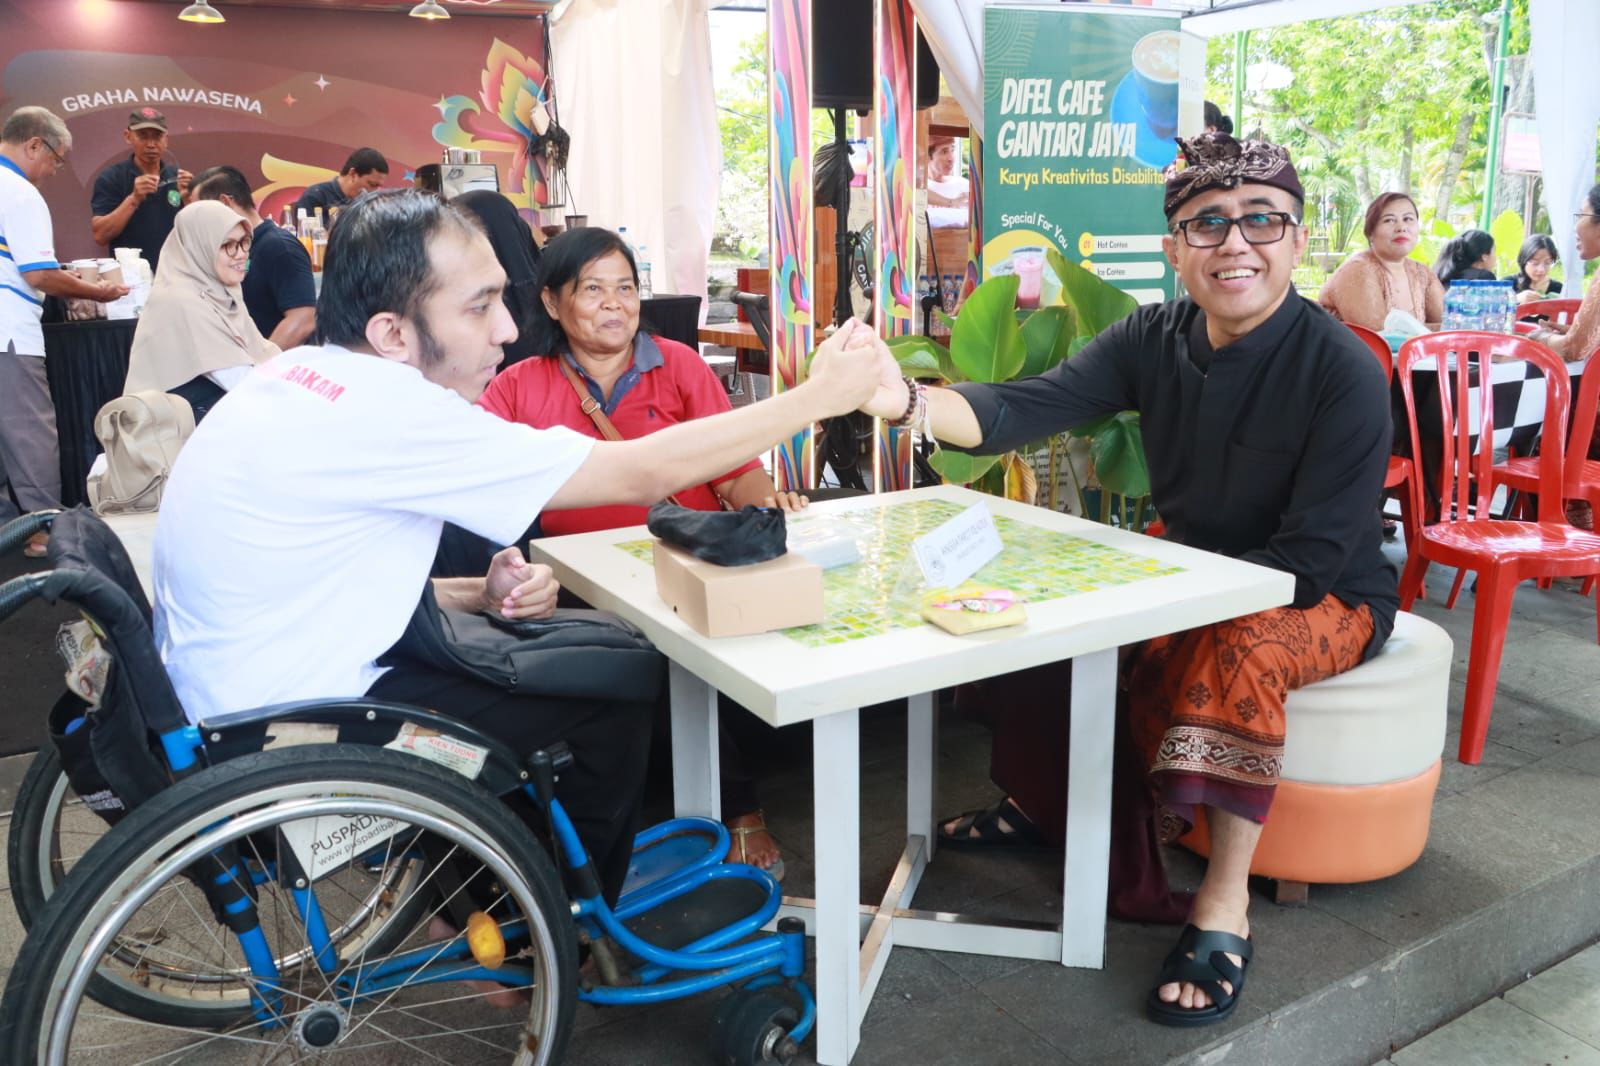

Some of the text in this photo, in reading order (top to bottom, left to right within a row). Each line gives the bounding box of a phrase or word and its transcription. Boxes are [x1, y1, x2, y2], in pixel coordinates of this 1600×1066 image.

[61, 87, 263, 114] GRAHA NAWASENA
[1000, 77, 1106, 116] DIFEL CAFE
[997, 120, 1137, 159] GANTARI JAYA
[999, 167, 1165, 191] Karya Kreativitas Disabilita
[1001, 211, 1068, 249] Special For You
[318, 818, 400, 866] www.puspadiba
